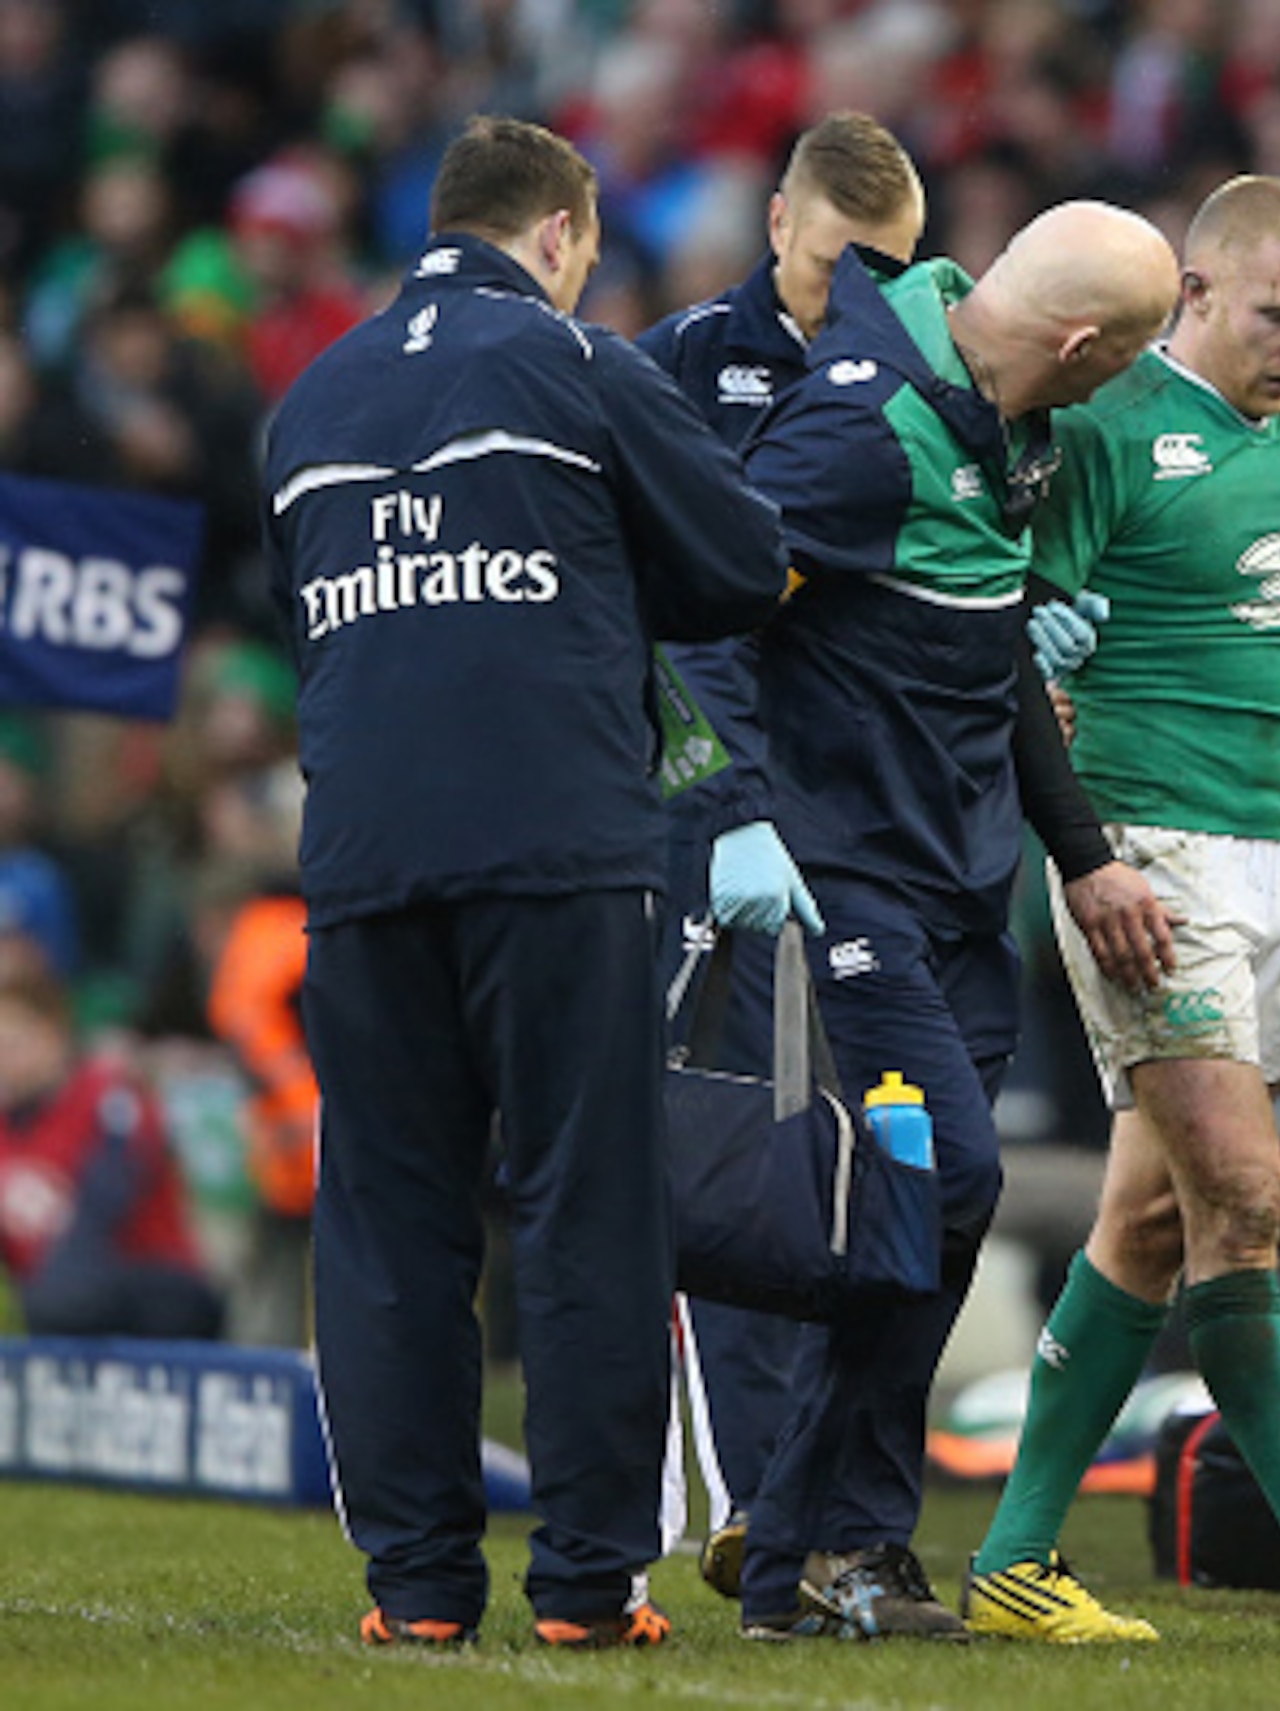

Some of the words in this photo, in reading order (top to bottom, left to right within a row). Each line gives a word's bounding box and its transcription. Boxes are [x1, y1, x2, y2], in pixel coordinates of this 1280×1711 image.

[371, 488, 442, 543] Fly
[10, 546, 187, 660] RBS
[299, 541, 560, 641] Emirates
